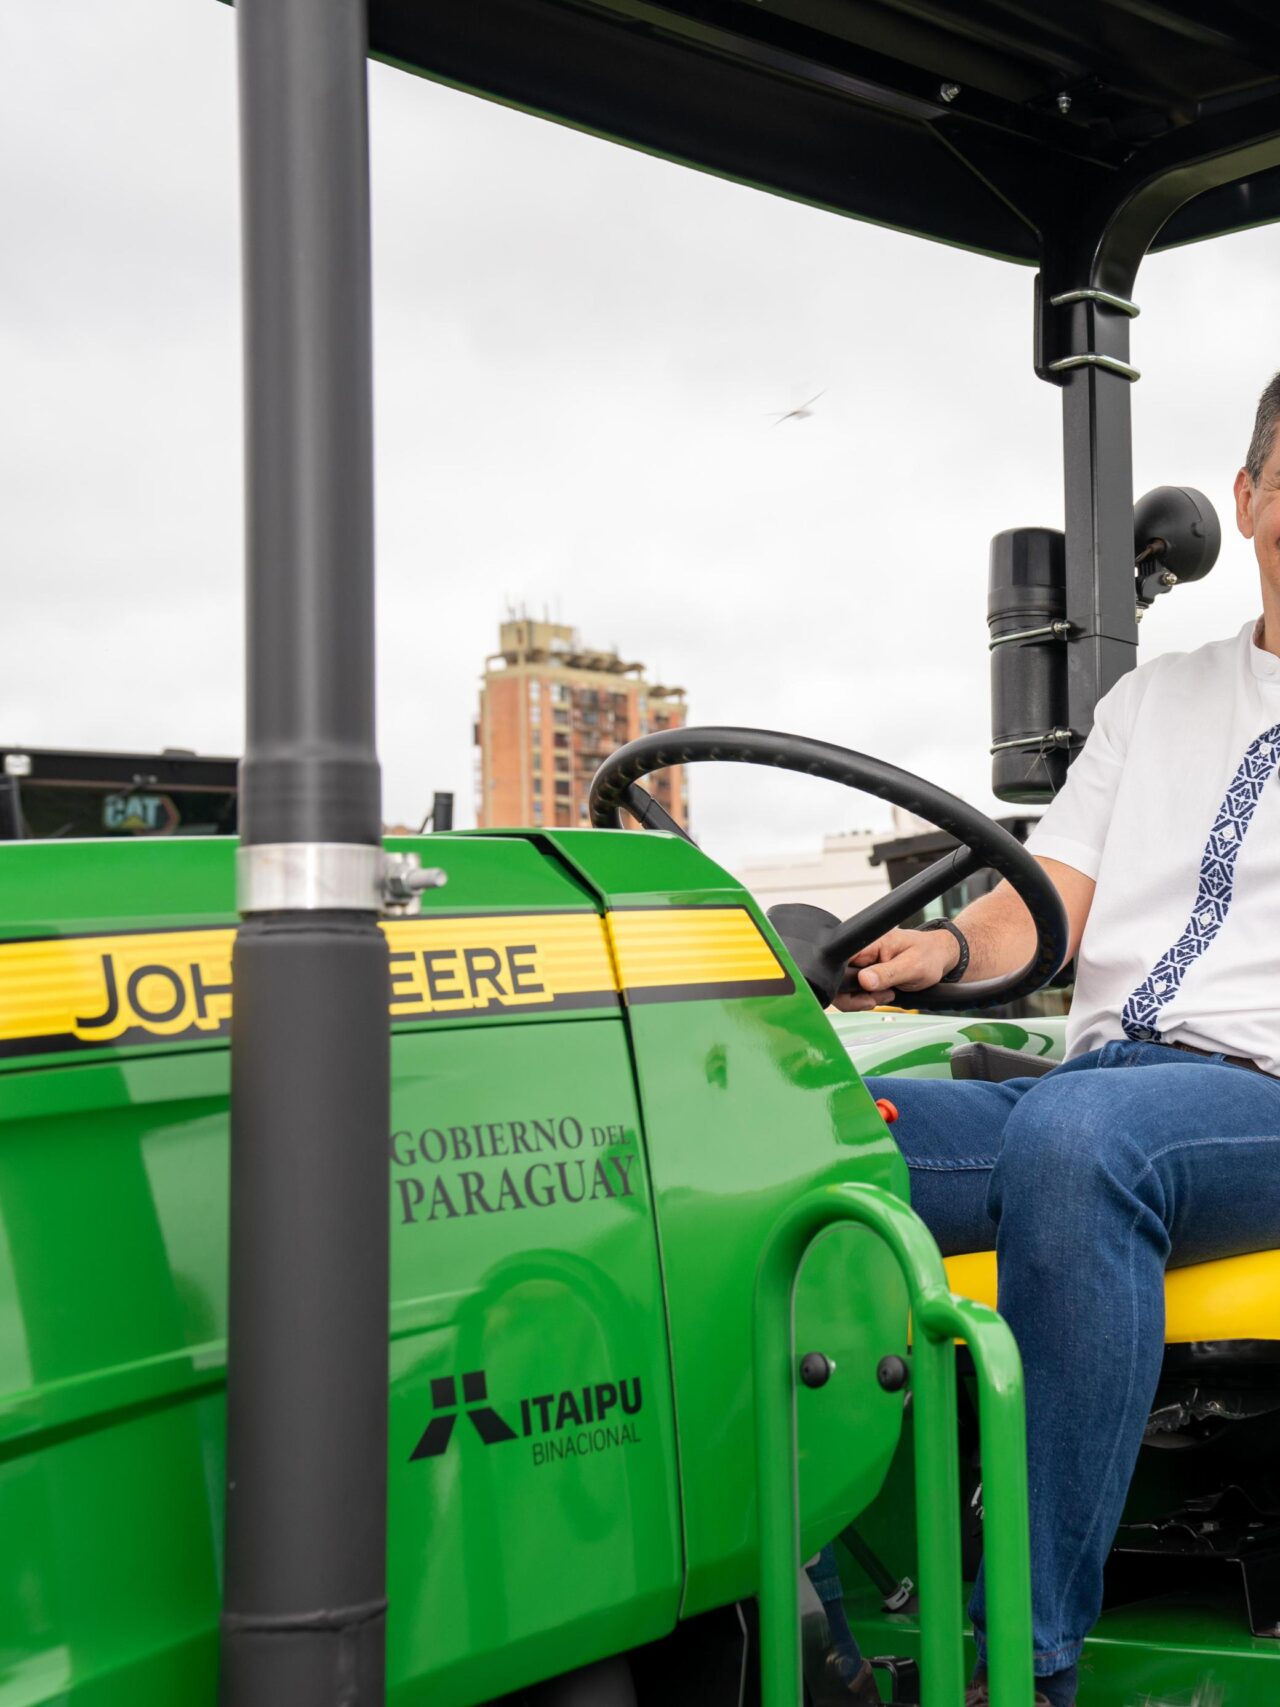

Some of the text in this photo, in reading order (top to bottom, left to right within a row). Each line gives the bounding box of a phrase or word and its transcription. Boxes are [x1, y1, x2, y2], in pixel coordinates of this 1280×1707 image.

[104, 794, 161, 829] CAT
[75, 944, 545, 1028] JOH EERE
[389, 1116, 631, 1167] GOBIERNO DEL
[395, 1154, 635, 1225] PARAGUAY
[520, 1376, 643, 1437] ITAIPU
[532, 1422, 641, 1467] BINACIONAL
